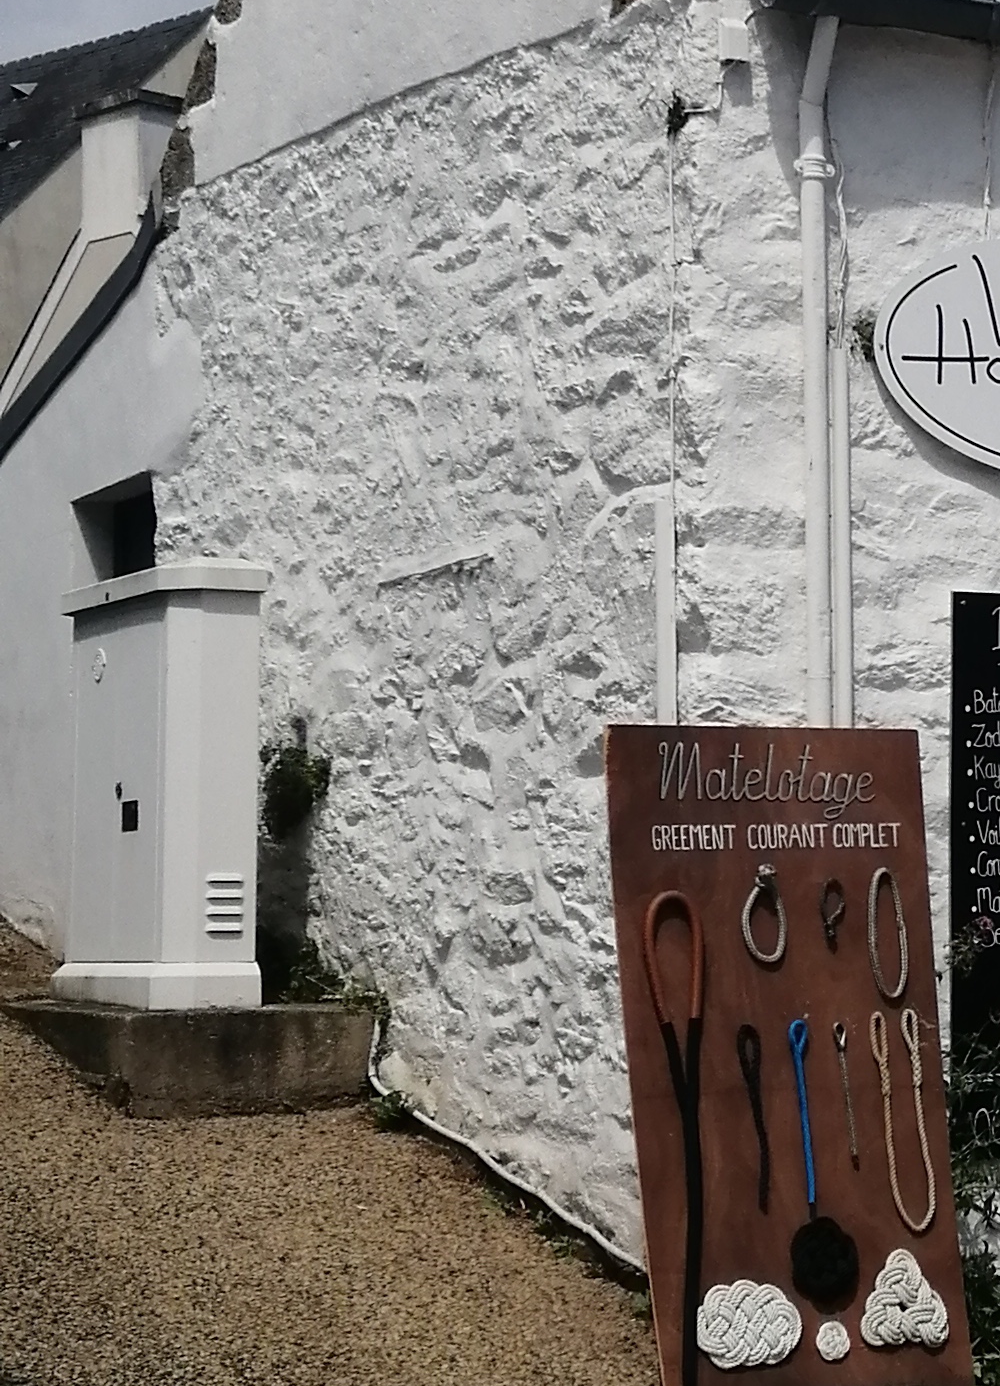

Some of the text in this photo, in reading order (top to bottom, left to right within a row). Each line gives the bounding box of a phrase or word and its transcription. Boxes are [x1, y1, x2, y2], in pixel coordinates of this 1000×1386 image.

[659, 741, 876, 819] Matelotage
[652, 822, 901, 851] GREEMENT COURANT COMPLET
